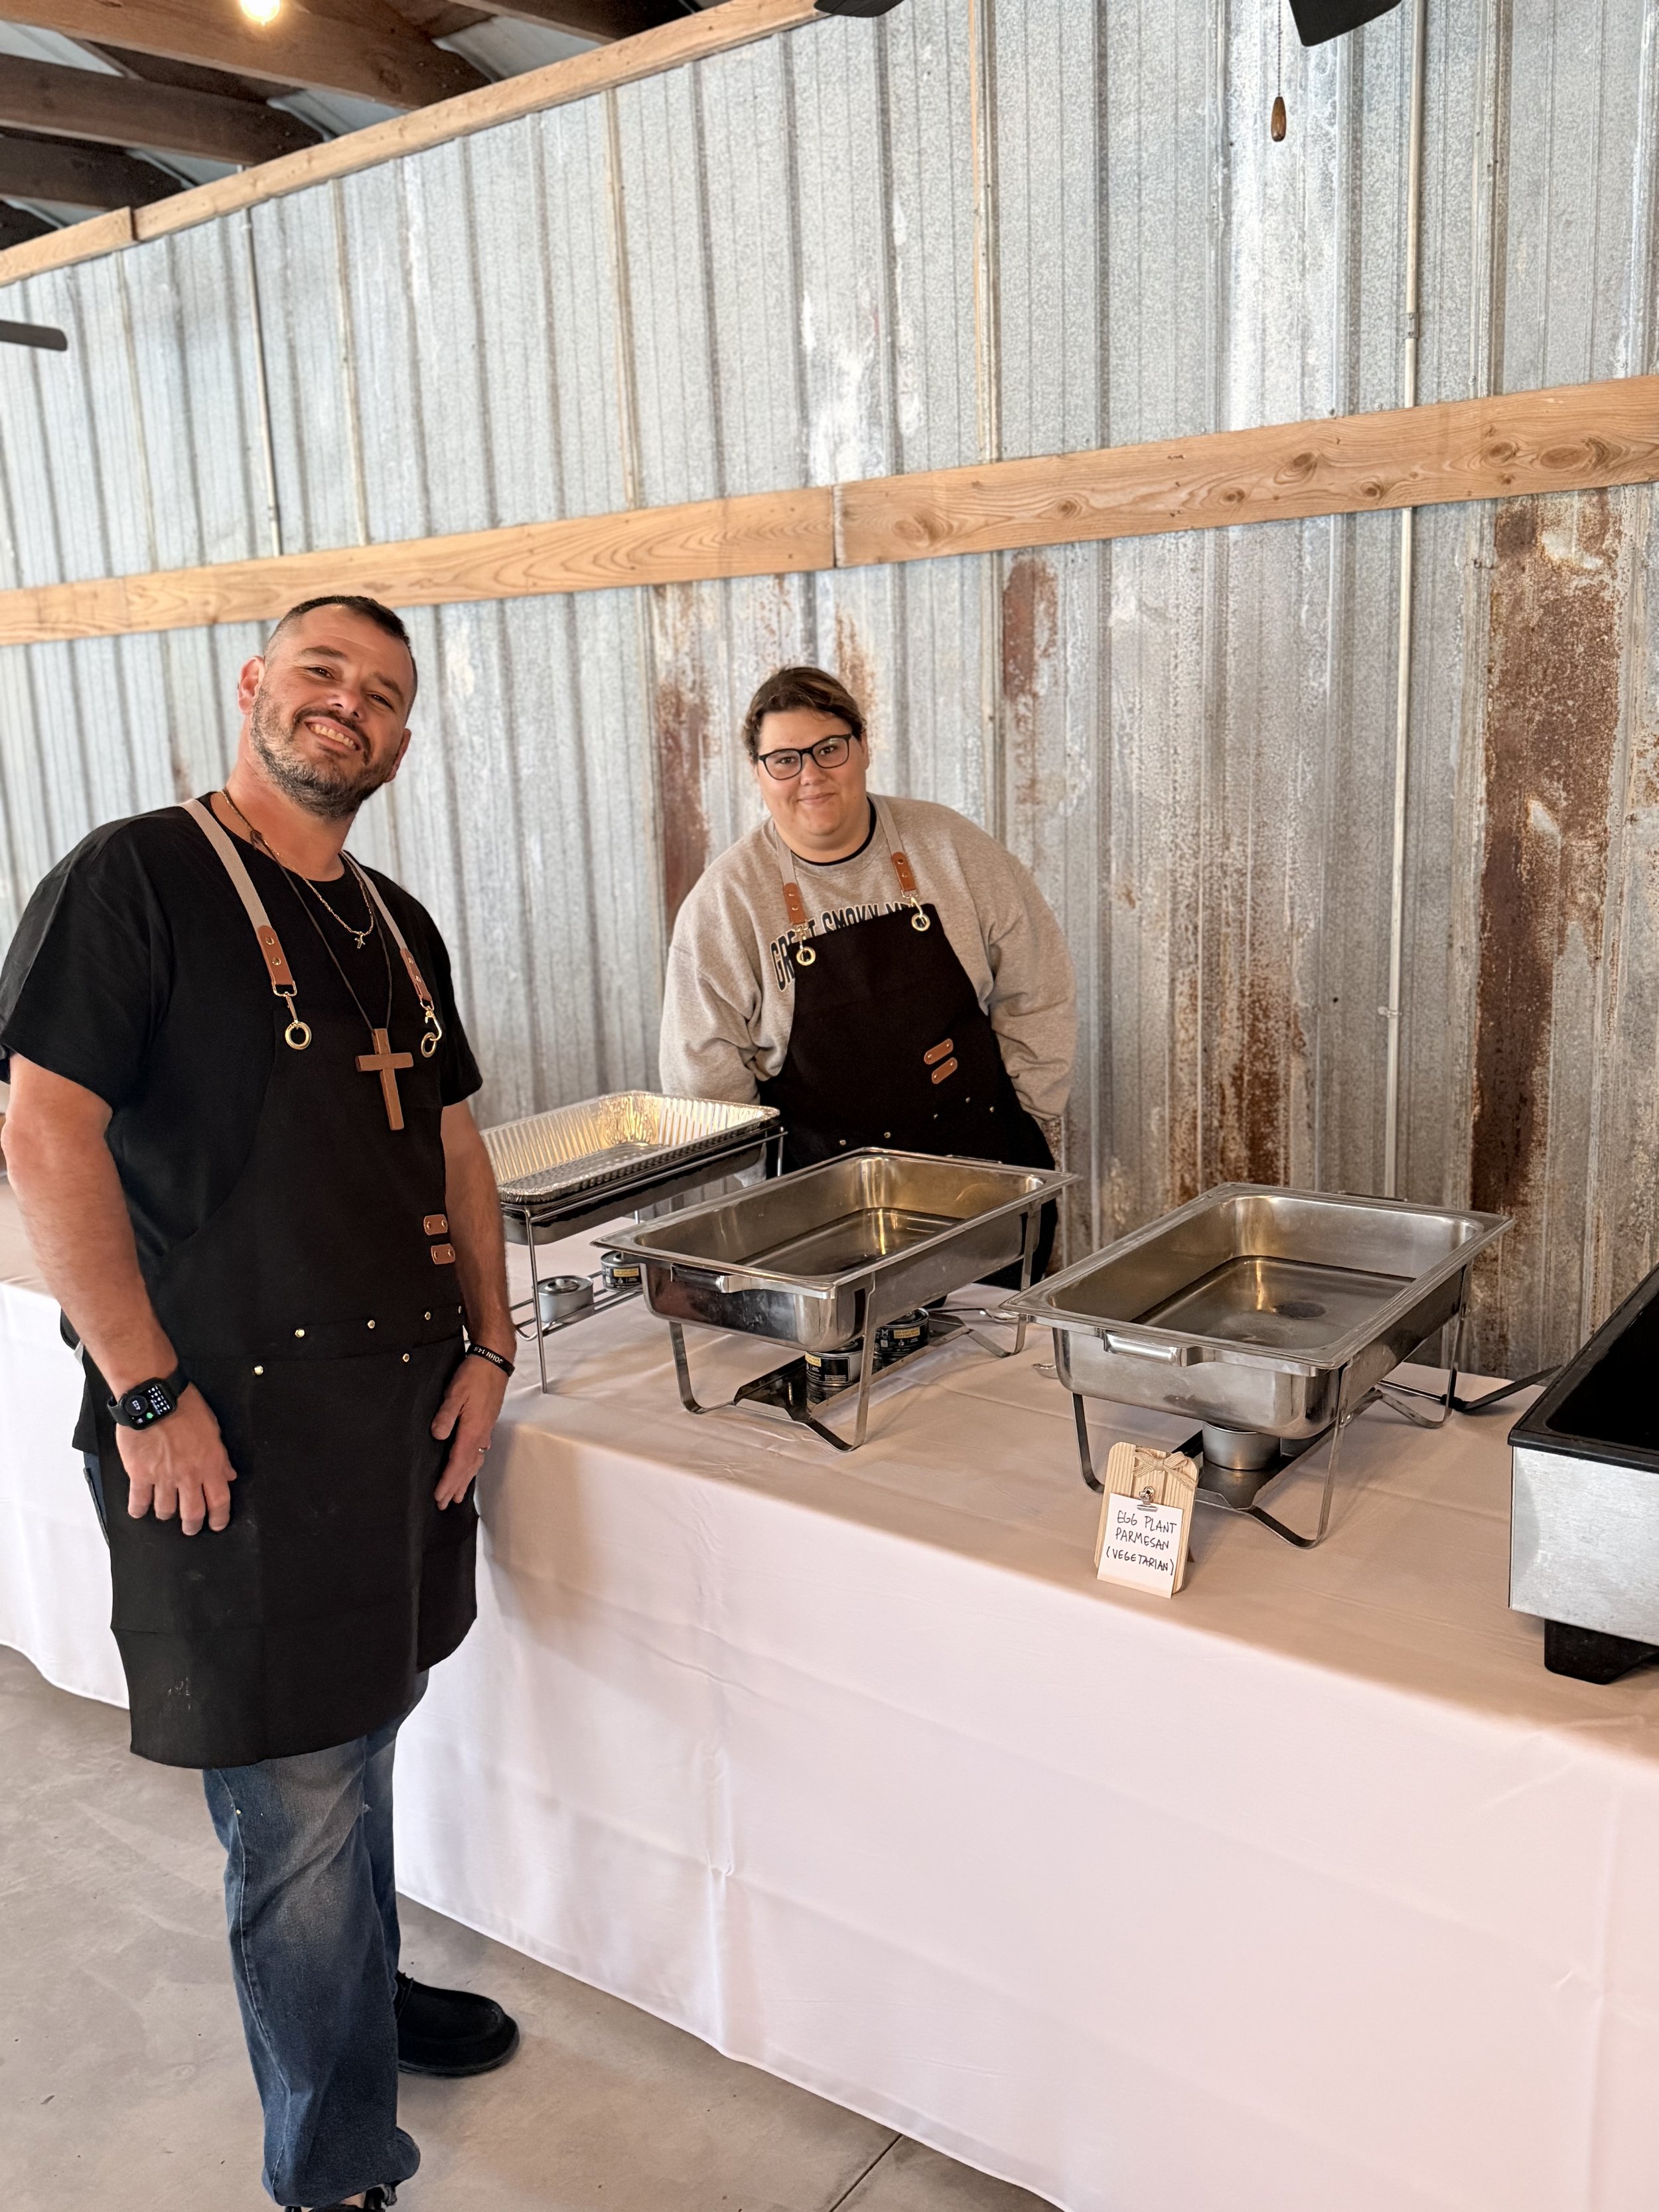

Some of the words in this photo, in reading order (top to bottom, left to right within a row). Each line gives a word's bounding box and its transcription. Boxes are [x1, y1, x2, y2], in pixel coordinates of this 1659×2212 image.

[486, 1351, 503, 1364] JOHN
[1117, 1510, 1137, 1526] EGG
[1144, 1515, 1177, 1533] PLANT
[1115, 1527, 1169, 1550] PARMESAN
[1106, 1546, 1174, 1576] (VEGETARIAN)
